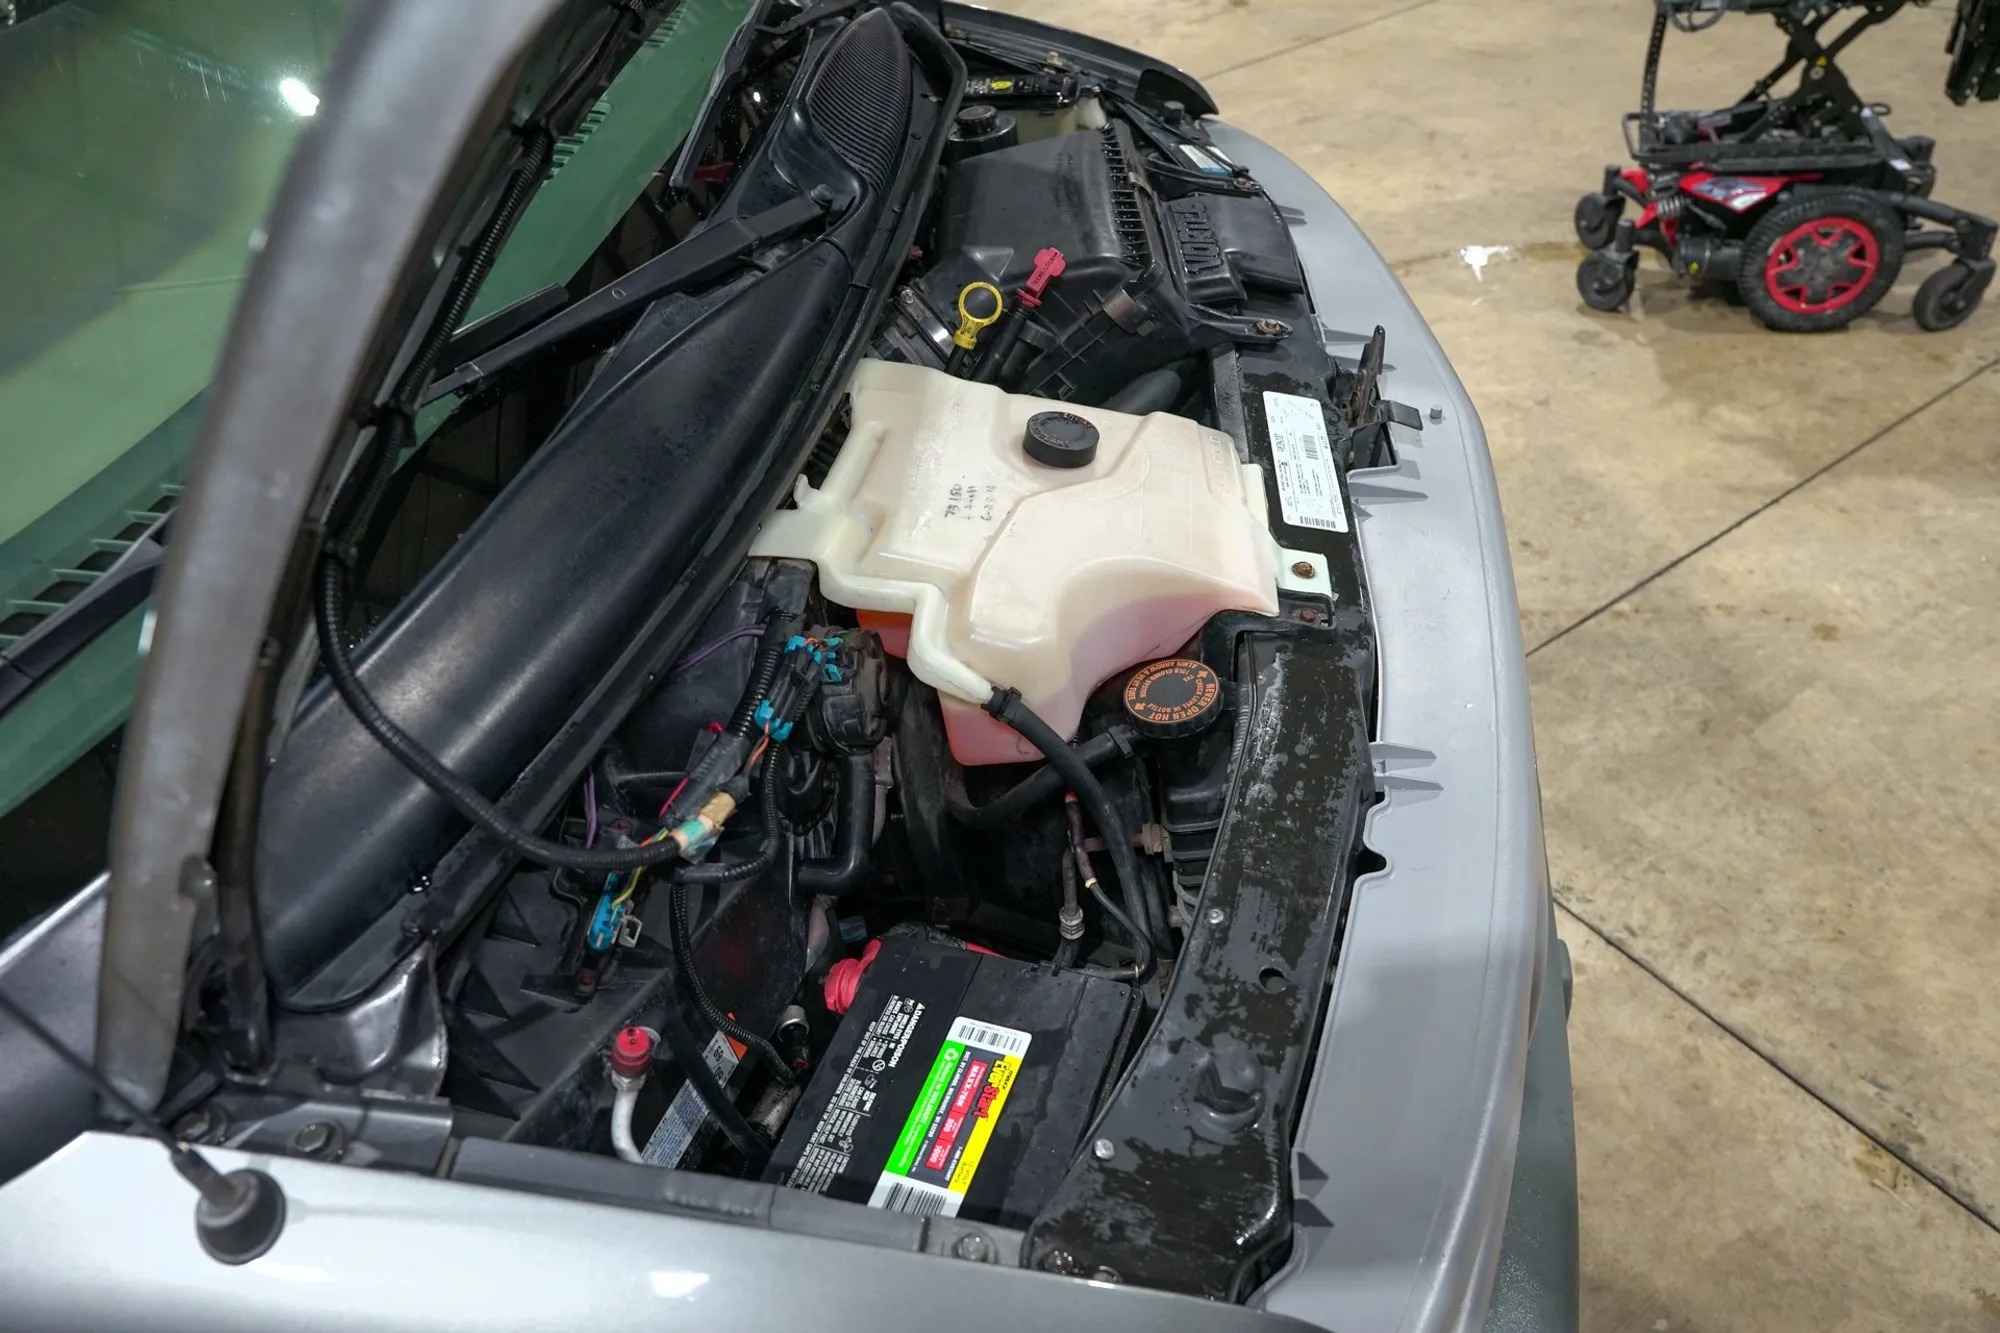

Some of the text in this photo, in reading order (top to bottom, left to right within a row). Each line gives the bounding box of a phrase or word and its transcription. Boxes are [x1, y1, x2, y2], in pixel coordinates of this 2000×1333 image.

[1150, 661, 1175, 673] ARROW
[1148, 683, 1215, 720] NEVER OPEN HOT
